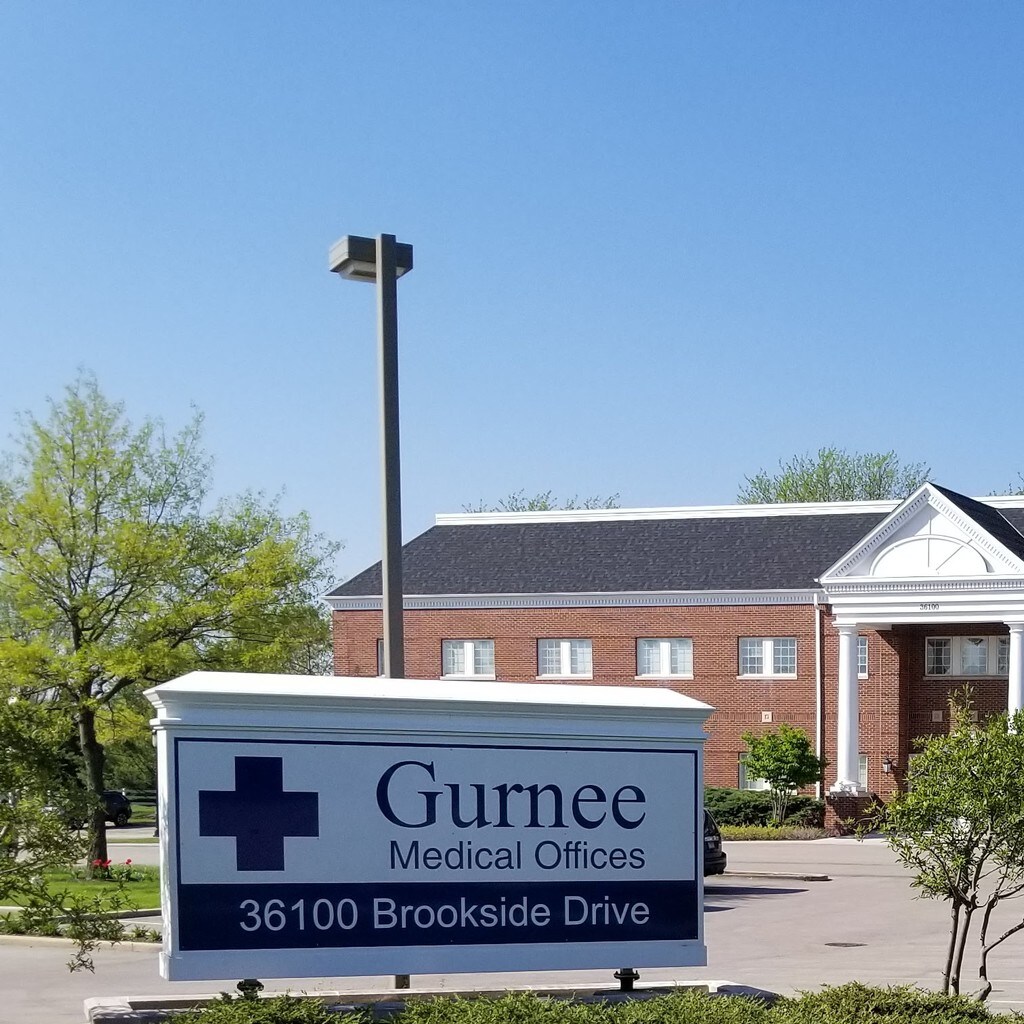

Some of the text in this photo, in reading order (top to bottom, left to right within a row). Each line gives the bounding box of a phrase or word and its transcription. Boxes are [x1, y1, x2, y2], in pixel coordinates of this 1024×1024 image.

[376, 760, 646, 830] Gurnee
[390, 840, 646, 871] Medical Offices
[239, 894, 650, 933] 36100 Brookside Drive
